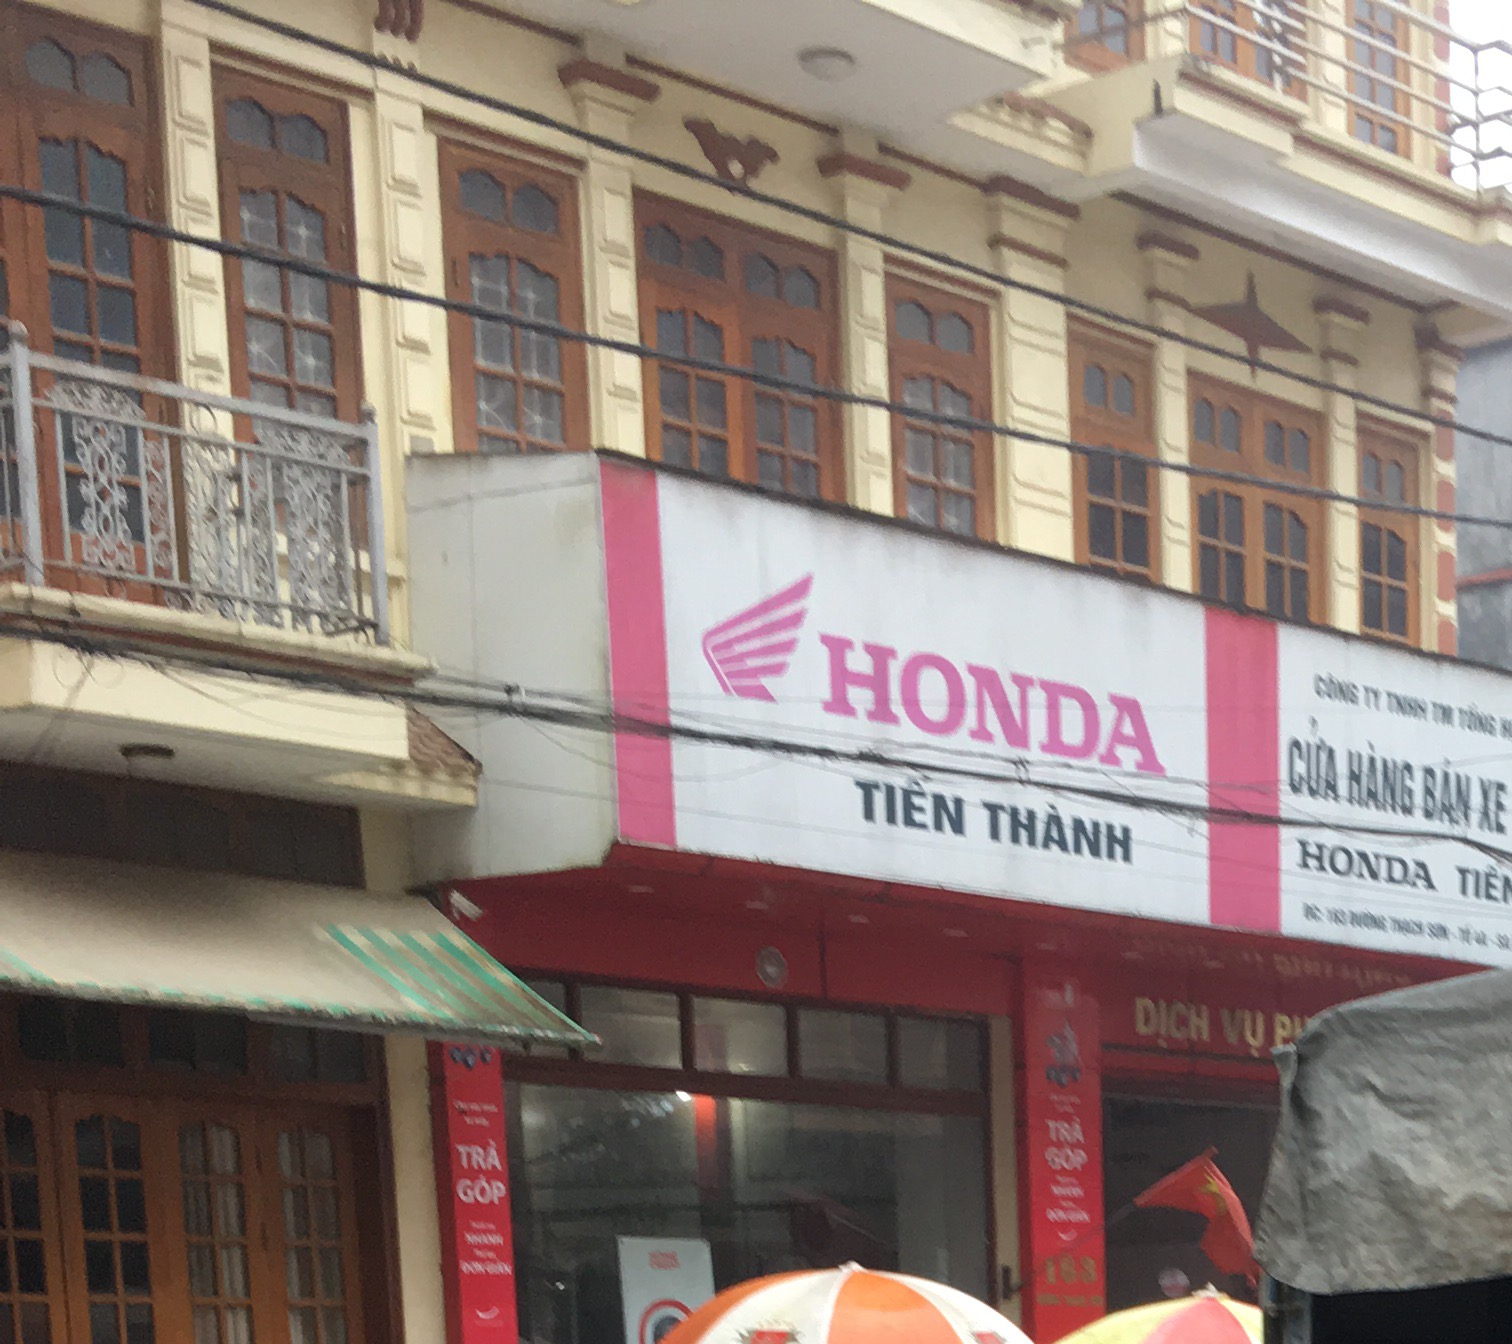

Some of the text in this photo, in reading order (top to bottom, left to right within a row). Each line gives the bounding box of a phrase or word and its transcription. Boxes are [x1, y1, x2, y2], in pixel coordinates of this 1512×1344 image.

[820, 633, 1166, 777] HONDA
[1288, 715, 1340, 801] CỬA
[1347, 740, 1414, 818] HÀNG
[1478, 775, 1507, 835] XE
[982, 801, 1133, 864] THÀNH
[1297, 838, 1438, 892] HONDA
[1135, 997, 1211, 1049] DỊCH
[1220, 1007, 1265, 1058] VỤ
[455, 1138, 502, 1171] TRẢ
